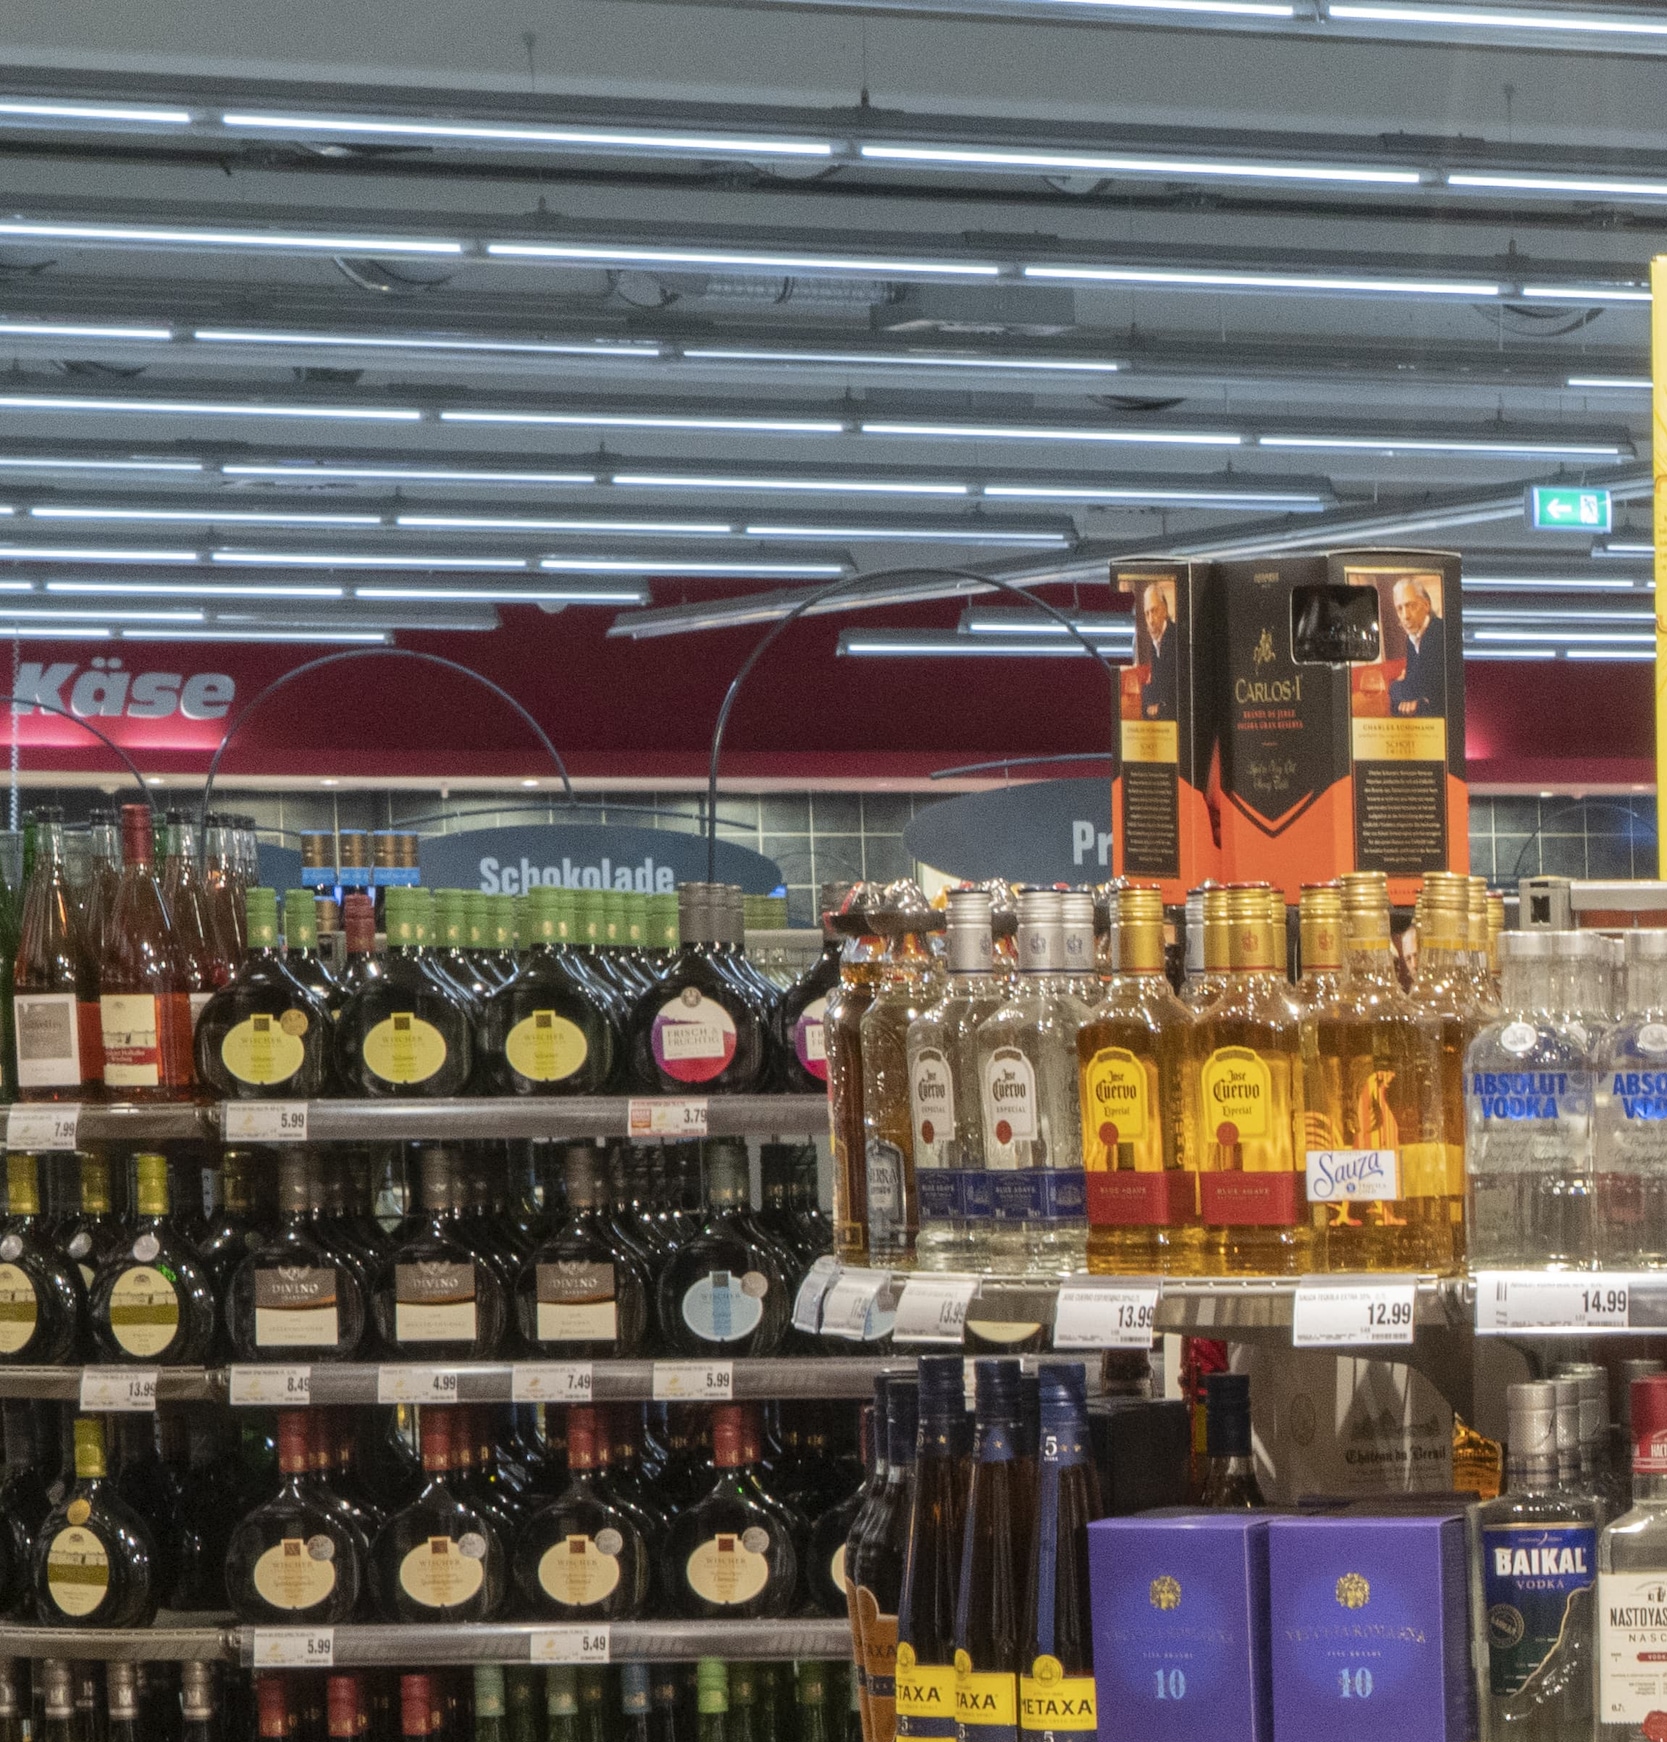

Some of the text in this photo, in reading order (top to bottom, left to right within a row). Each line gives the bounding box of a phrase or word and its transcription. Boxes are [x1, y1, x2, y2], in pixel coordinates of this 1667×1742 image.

[11, 657, 236, 720] Käse
[480, 857, 675, 896] Schokolade
[1096, 1082, 1136, 1102] Cuervo
[1213, 1082, 1260, 1103] Cuervo
[1472, 1072, 1567, 1094] ABSOLUT
[683, 1109, 706, 1126] 3.79
[1482, 1097, 1558, 1119] VODKA
[281, 1113, 305, 1128] 5.99
[1313, 1151, 1383, 1196] Sauza
[271, 1280, 319, 1295] DIVINO
[1367, 1303, 1411, 1325] 12.99
[432, 1374, 457, 1391] 4.99
[706, 1371, 730, 1388] 5.99
[1496, 1548, 1587, 1576] BAIKAL
[307, 1639, 331, 1656] 5.99
[582, 1635, 606, 1651] 5.49
[1155, 1669, 1185, 1700] 10
